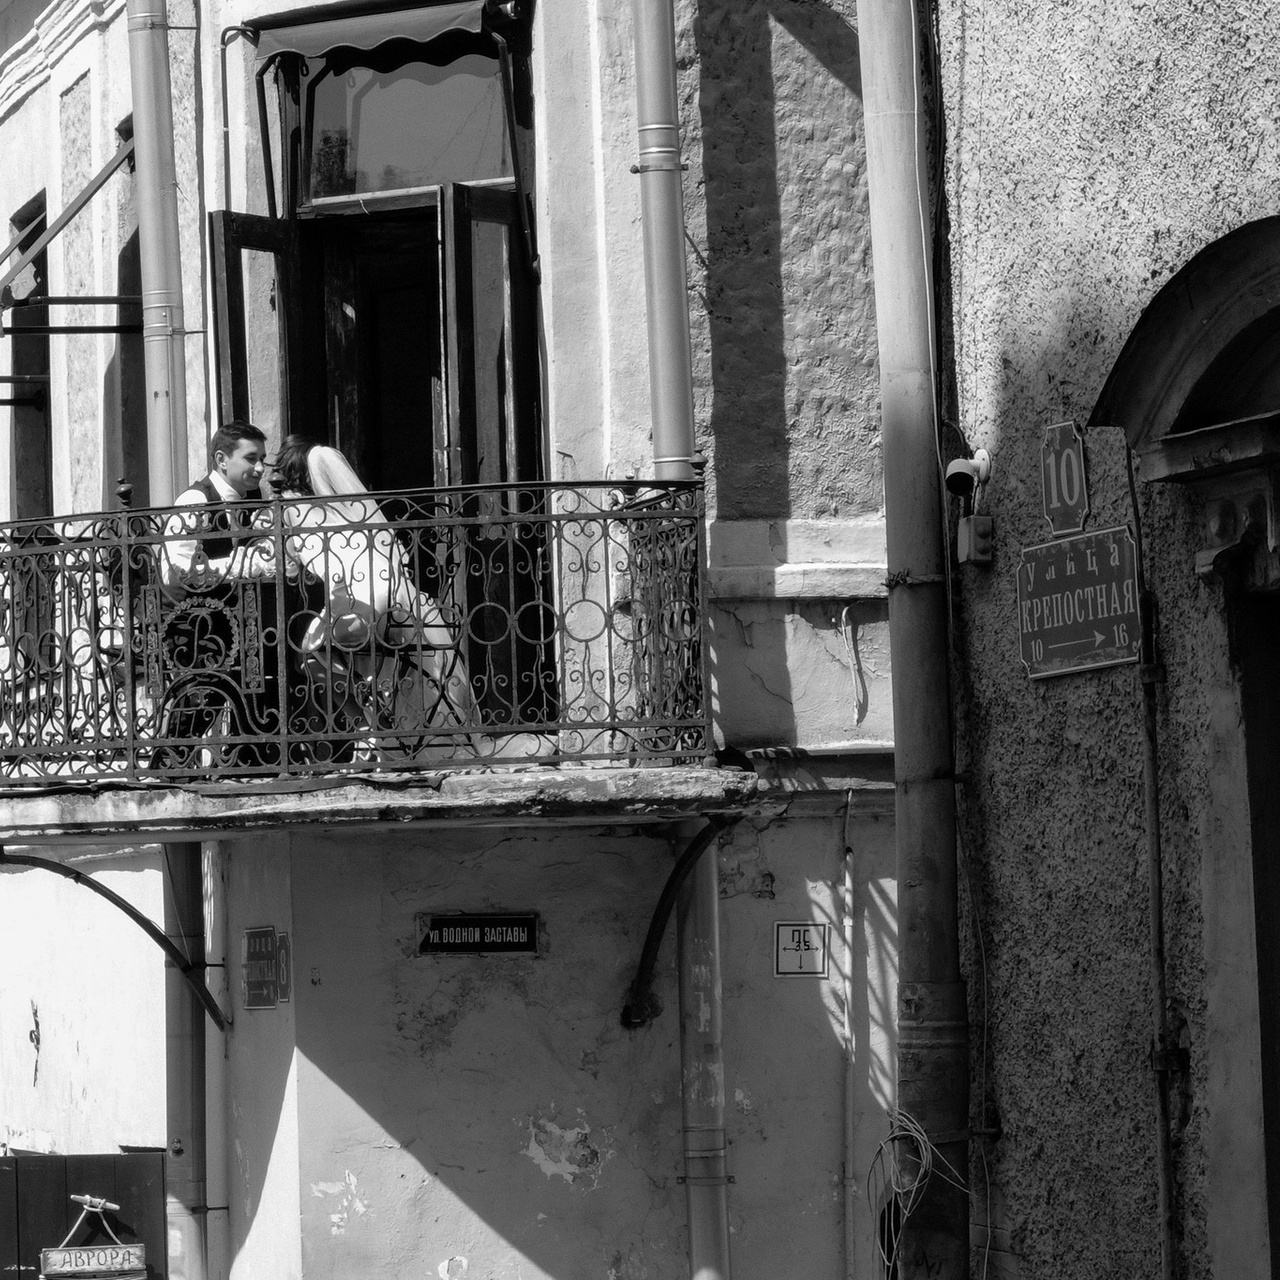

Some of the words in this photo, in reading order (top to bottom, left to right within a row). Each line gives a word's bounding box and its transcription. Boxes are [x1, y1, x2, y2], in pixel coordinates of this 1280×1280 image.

[1046, 447, 1080, 509] 10
[1027, 543, 1119, 592] улица
[1022, 579, 1135, 634] КРЕПОСТНАЯ
[1030, 638, 1044, 662] 10
[1112, 622, 1129, 648] 16
[442, 927, 480, 943] ВОДНОЙ
[484, 927, 527, 942] ЗАСТАВЫ
[280, 949, 286, 984] 8
[60, 1250, 133, 1269] АВРОРА
